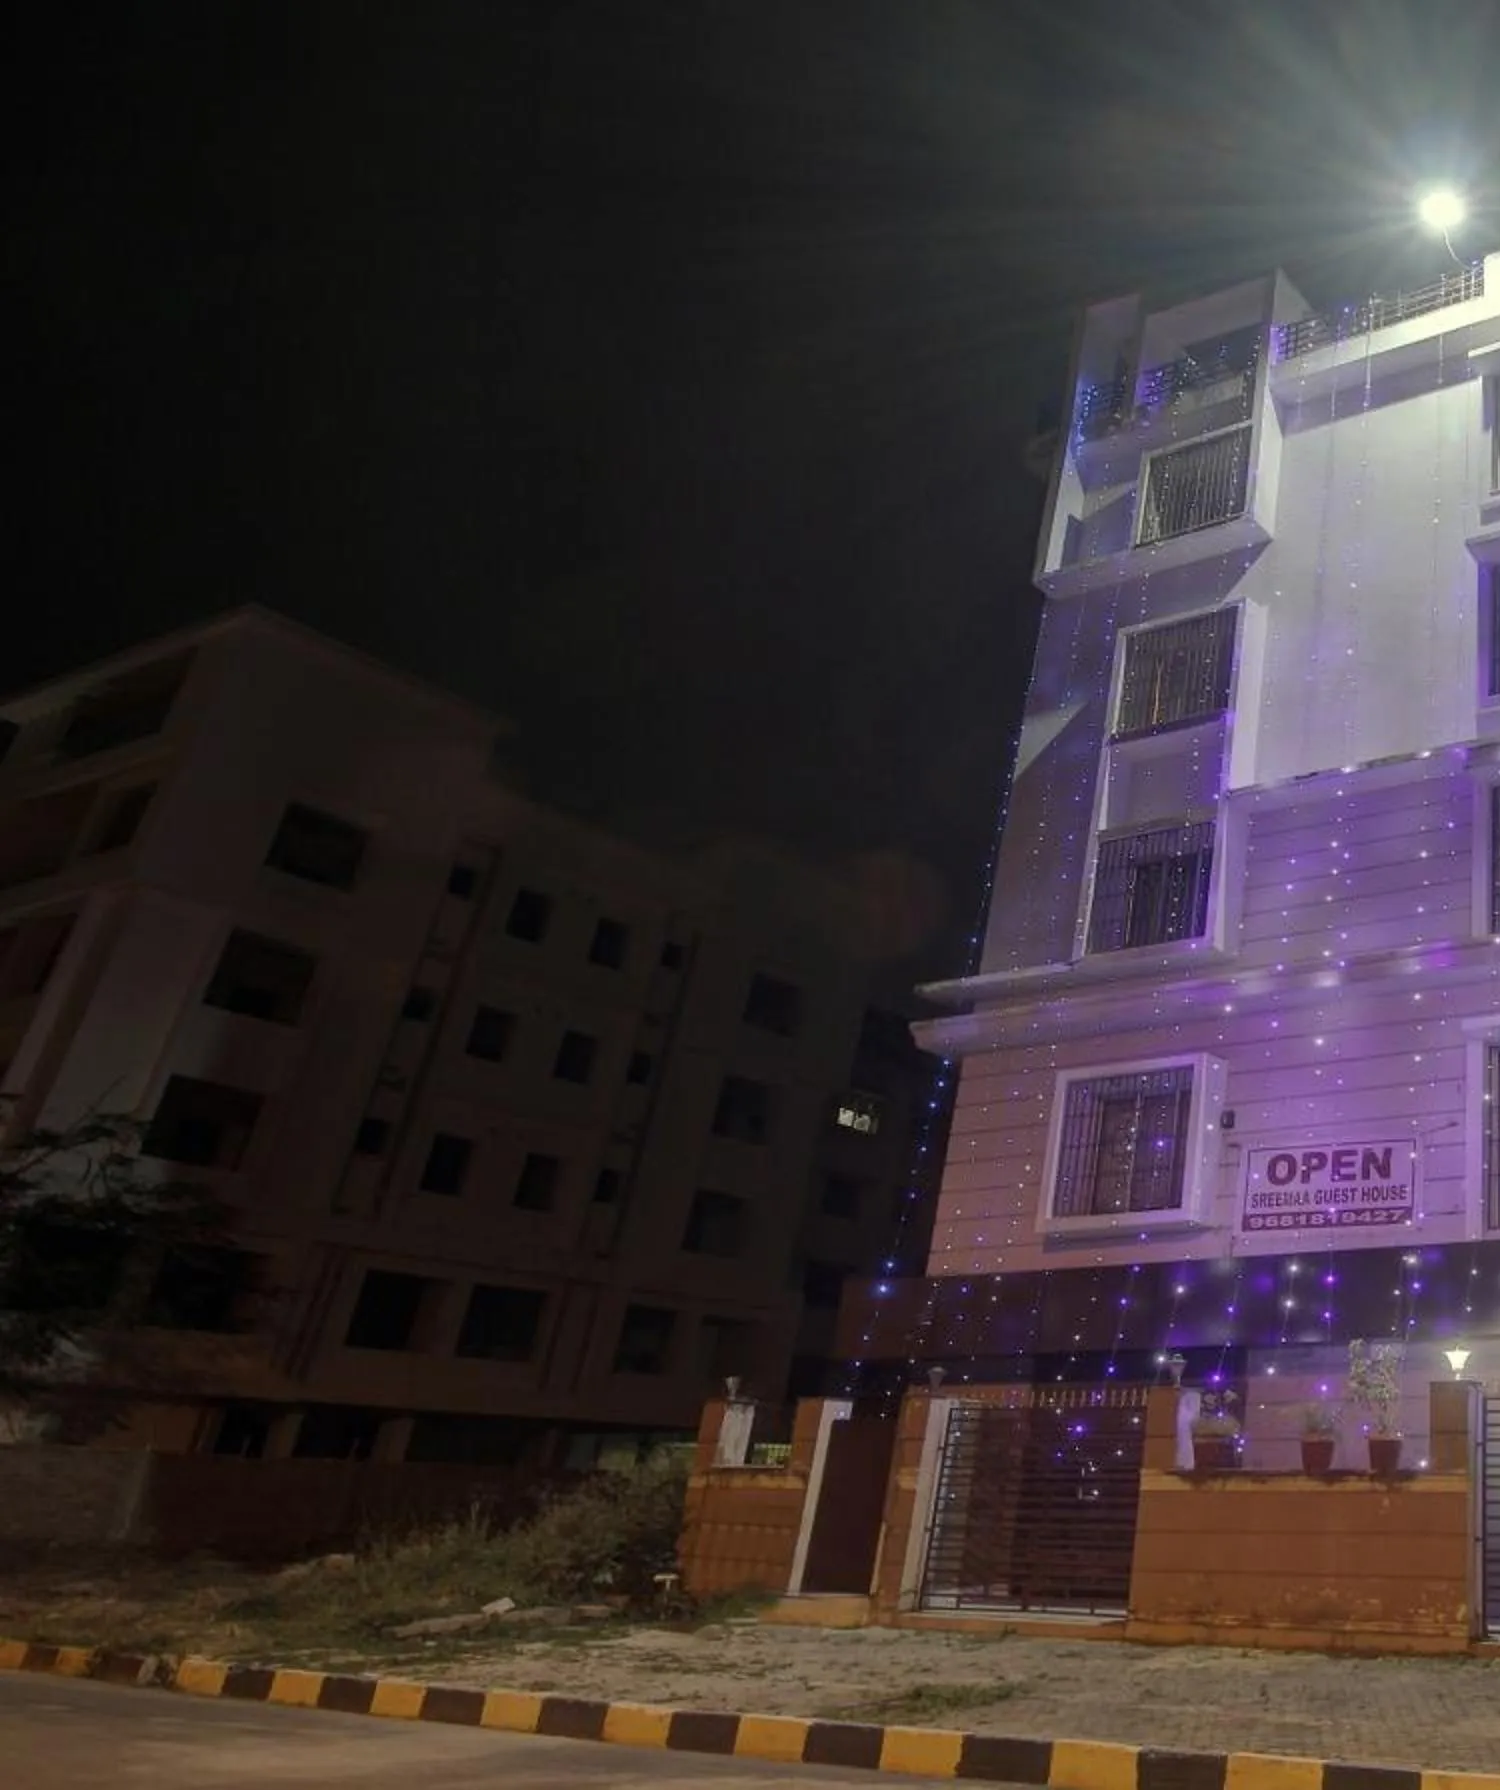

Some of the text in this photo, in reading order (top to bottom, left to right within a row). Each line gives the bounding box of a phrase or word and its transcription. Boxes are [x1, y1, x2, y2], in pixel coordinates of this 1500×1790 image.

[1267, 1147, 1393, 1186] OPEN
[1314, 1188, 1358, 1205] GUEST
[1361, 1185, 1408, 1202] HOUSE
